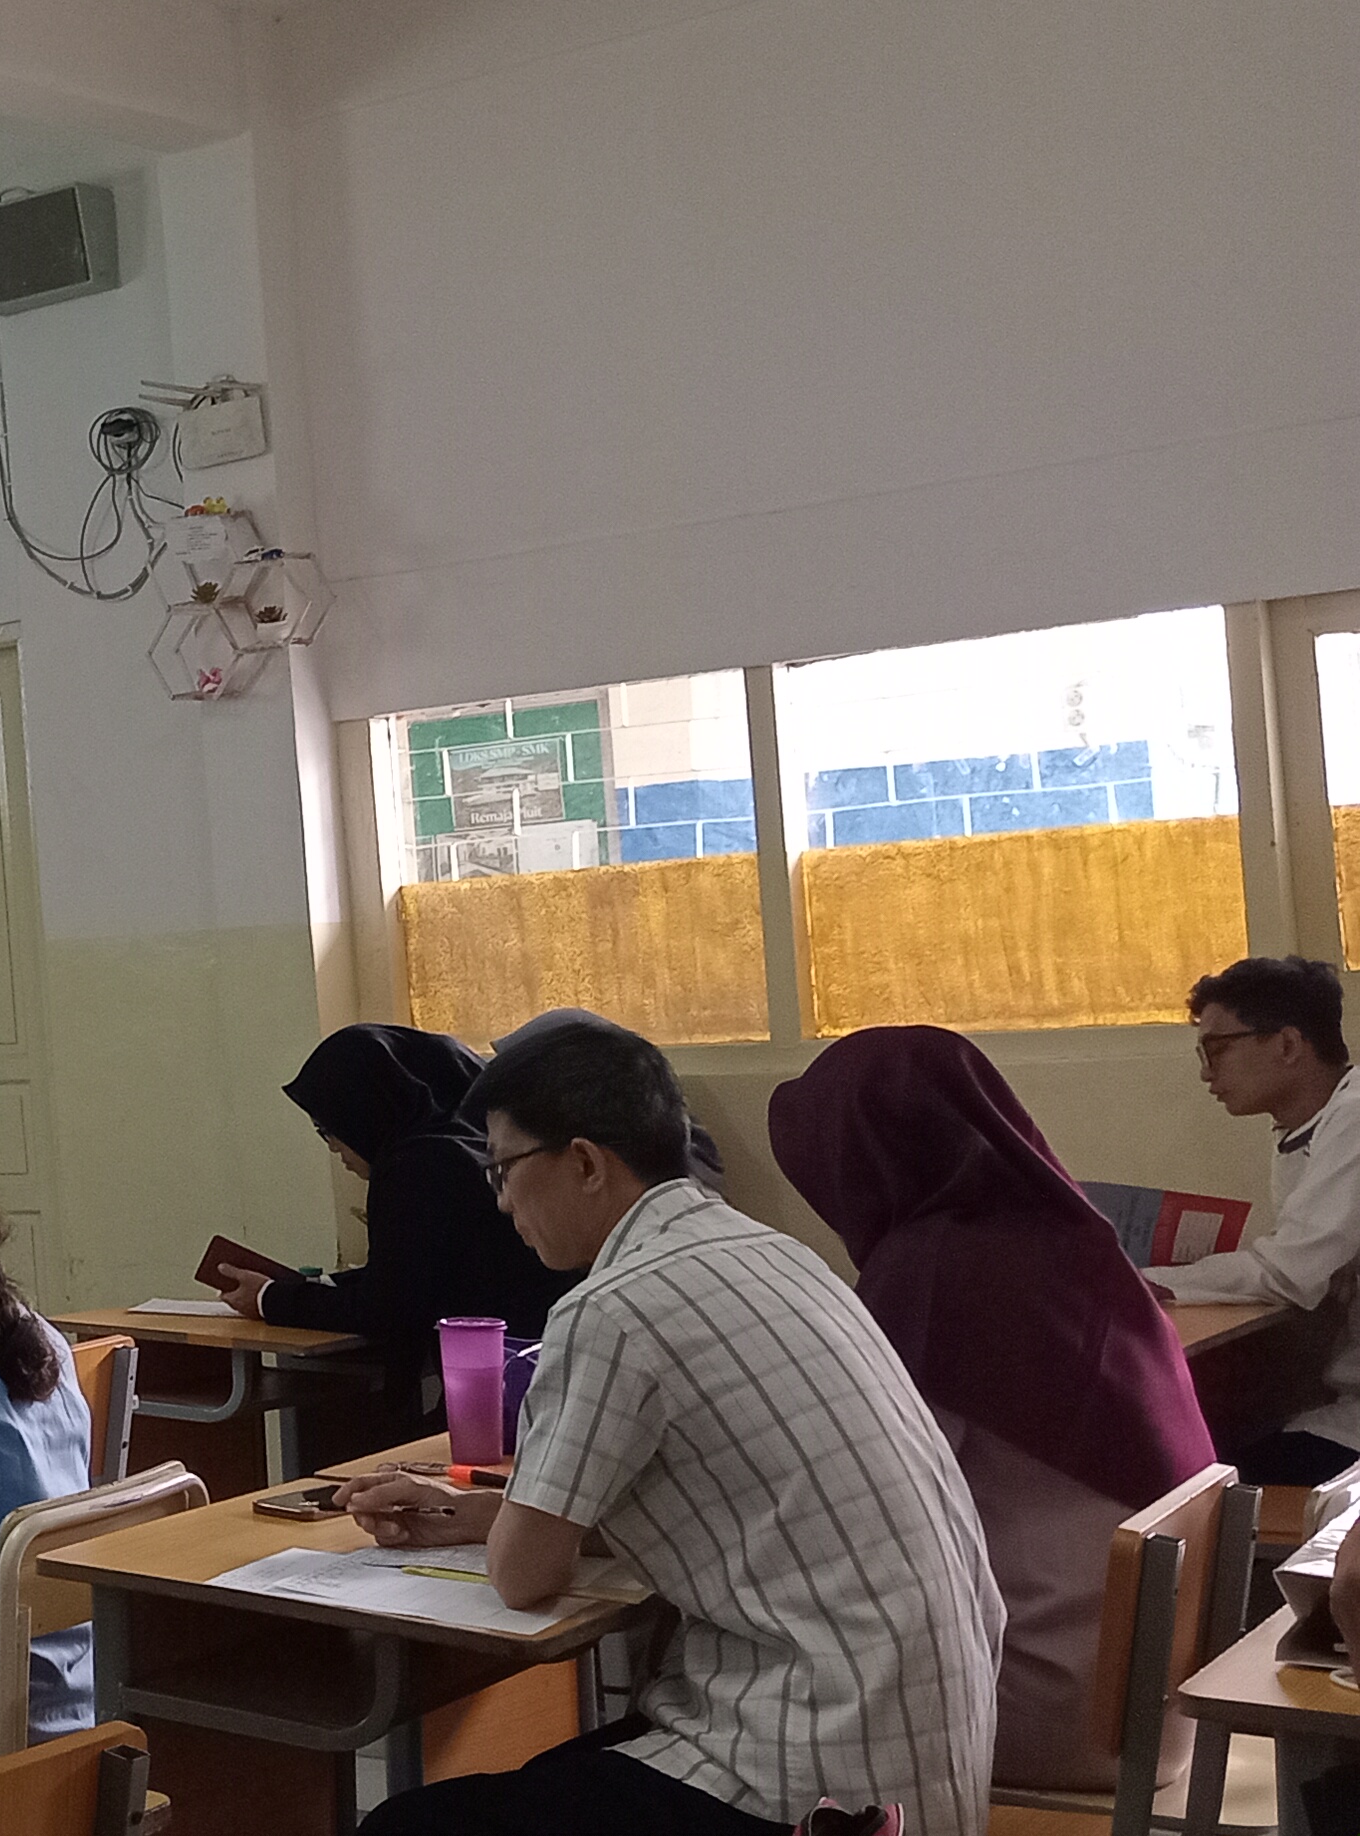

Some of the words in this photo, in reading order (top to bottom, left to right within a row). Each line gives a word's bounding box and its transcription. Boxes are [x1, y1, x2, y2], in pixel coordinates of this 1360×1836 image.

[522, 742, 551, 757] SMK
[470, 808, 515, 825] Remaja
[516, 804, 544, 819] luit
